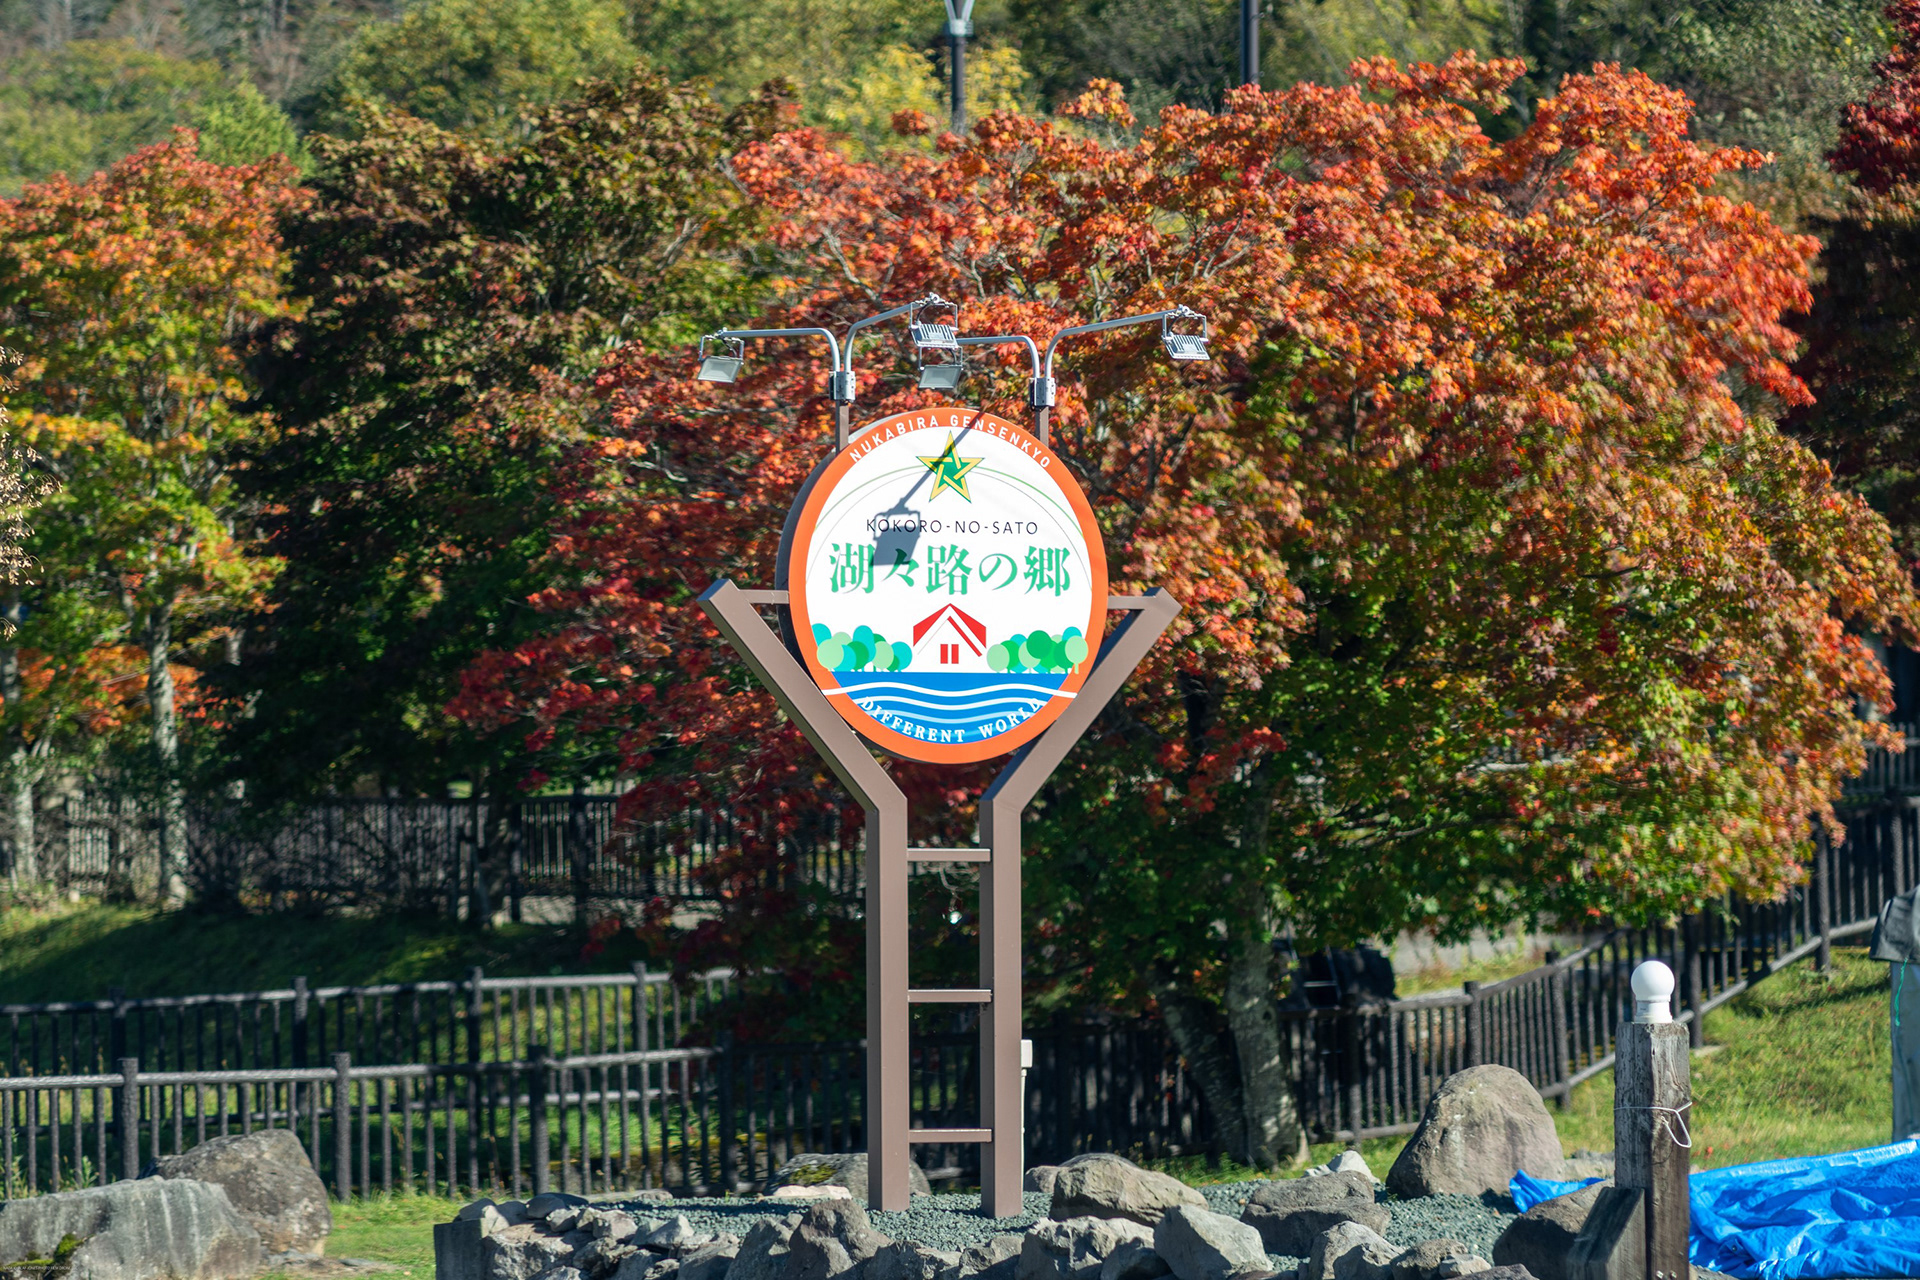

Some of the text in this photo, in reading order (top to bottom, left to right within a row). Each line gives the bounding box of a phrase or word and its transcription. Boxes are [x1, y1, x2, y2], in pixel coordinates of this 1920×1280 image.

[849, 415, 1049, 468] NUKABIRA GENSENKYO
[866, 518, 1038, 534] KOKORO-NO-SATO
[829, 542, 1070, 597] 湖々路の郷
[861, 697, 1042, 742] DIFFERENT WORLD
